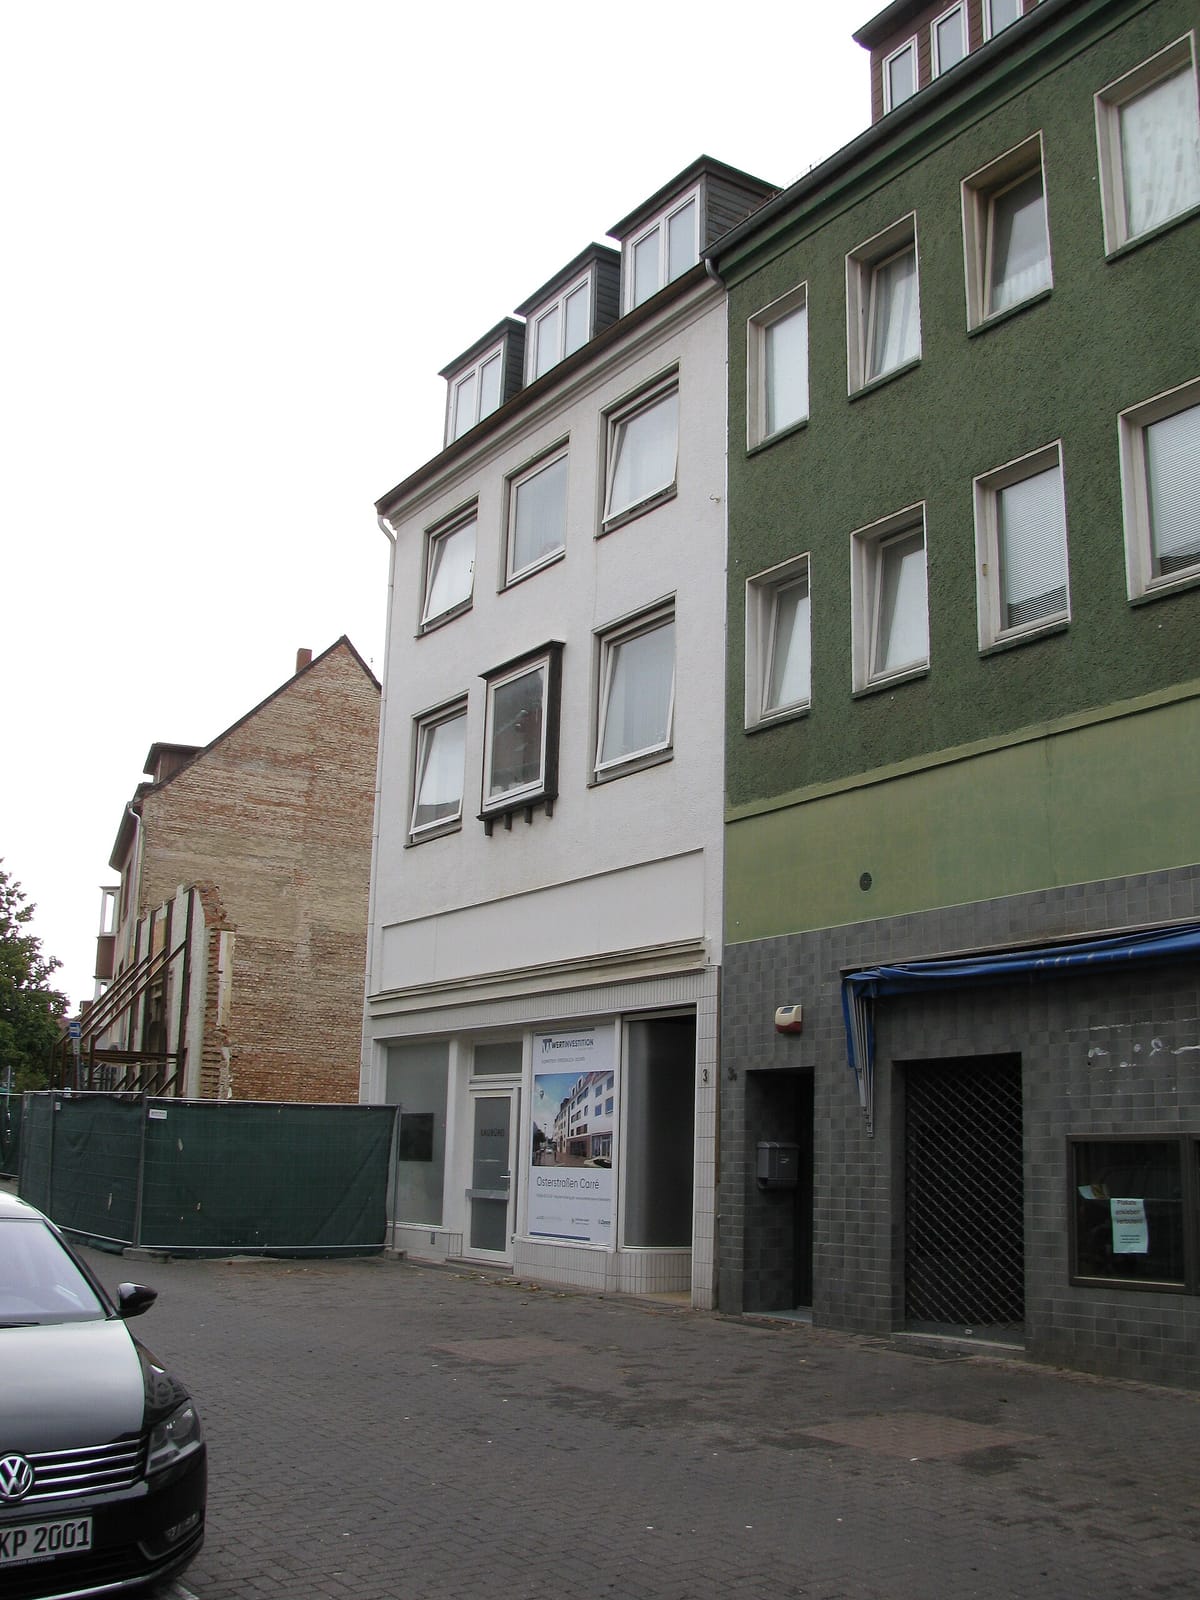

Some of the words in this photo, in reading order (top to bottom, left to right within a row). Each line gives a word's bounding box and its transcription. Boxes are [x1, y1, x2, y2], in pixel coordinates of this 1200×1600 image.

[702, 1068, 708, 1082] 3
[536, 1176, 579, 1189] Osterstraßen
[579, 1178, 600, 1190] Carré
[33, 1520, 89, 1553] 2001
